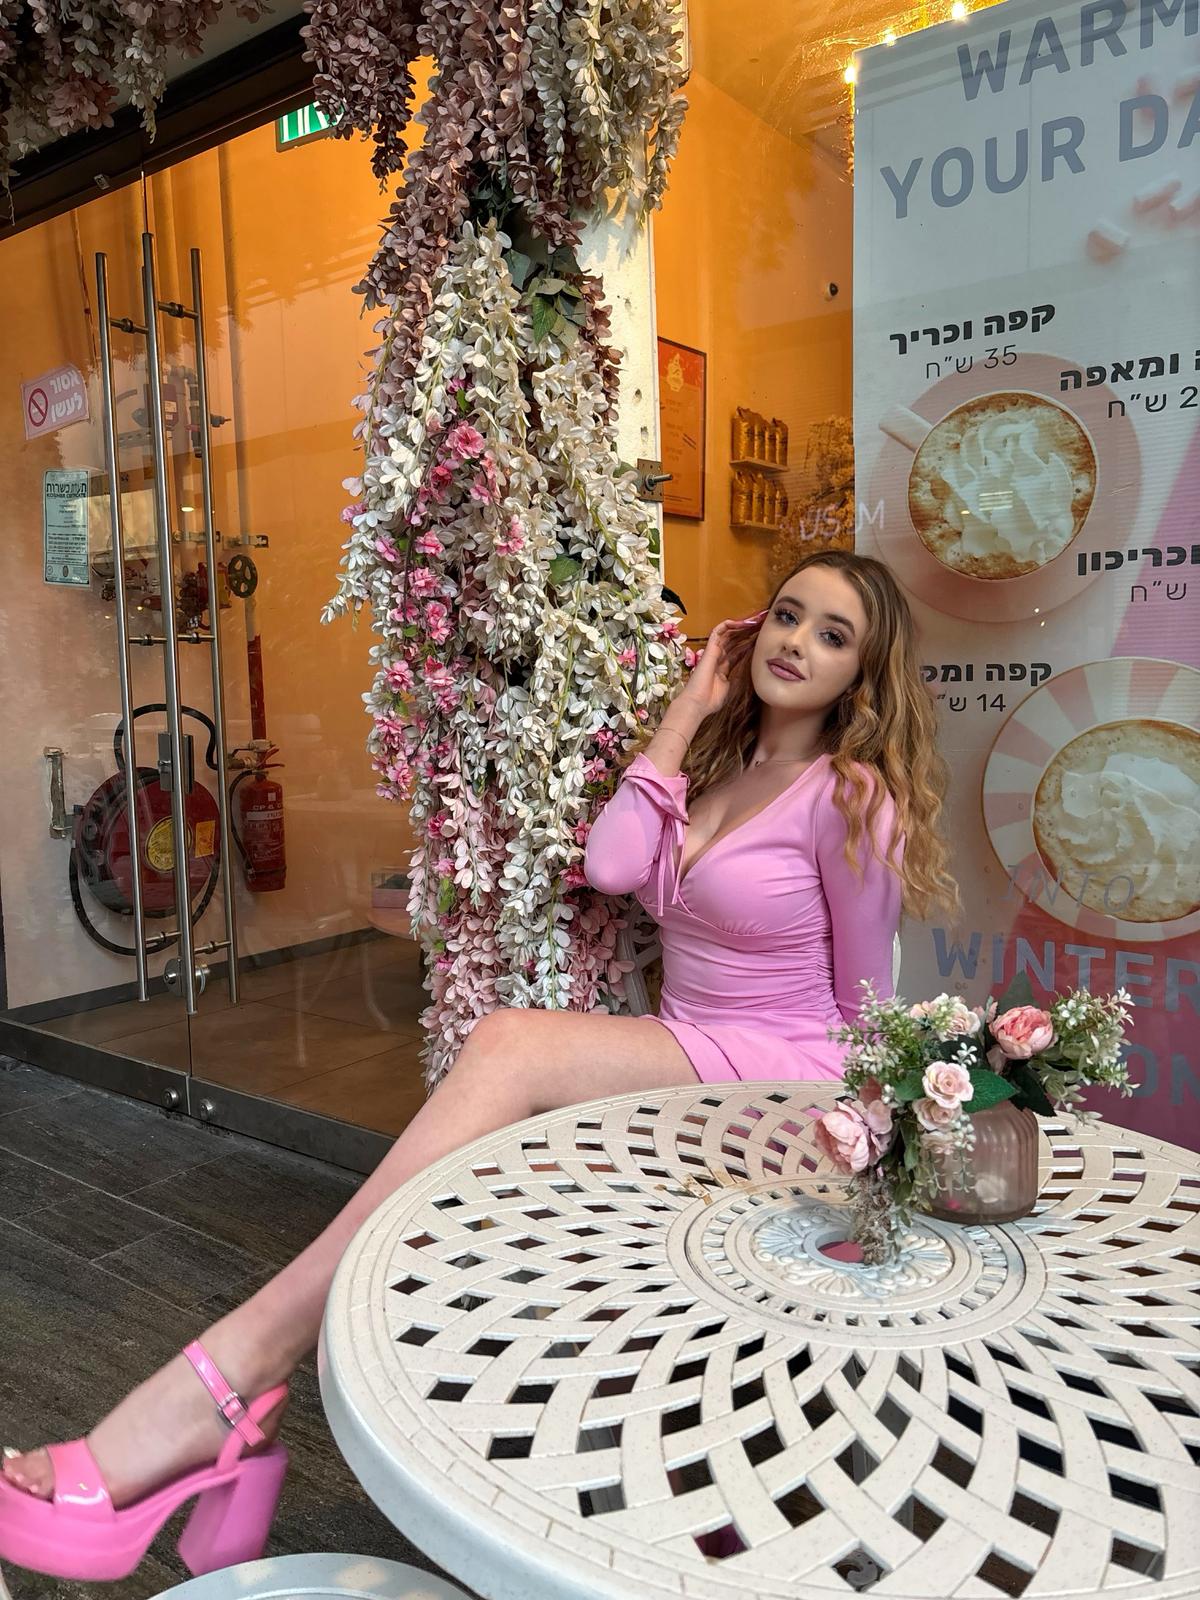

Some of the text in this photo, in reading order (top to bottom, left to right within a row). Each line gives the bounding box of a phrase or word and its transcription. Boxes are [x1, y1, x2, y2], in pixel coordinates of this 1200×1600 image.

[957, 0, 1199, 101] WARM
[880, 116, 1086, 219] YOUR
[889, 304, 1056, 355] קפה וכריך
[984, 344, 1018, 370] 35
[1060, 353, 1179, 391] ומאפה
[49, 369, 80, 394] אסור
[51, 392, 83, 423] לעשן
[1078, 545, 1200, 576] וכריכון
[919, 662, 1052, 687] קפה ומק
[936, 693, 1006, 712] 14 ש"
[1000, 864, 1135, 913] INTO
[932, 928, 1200, 1017] WINTER
